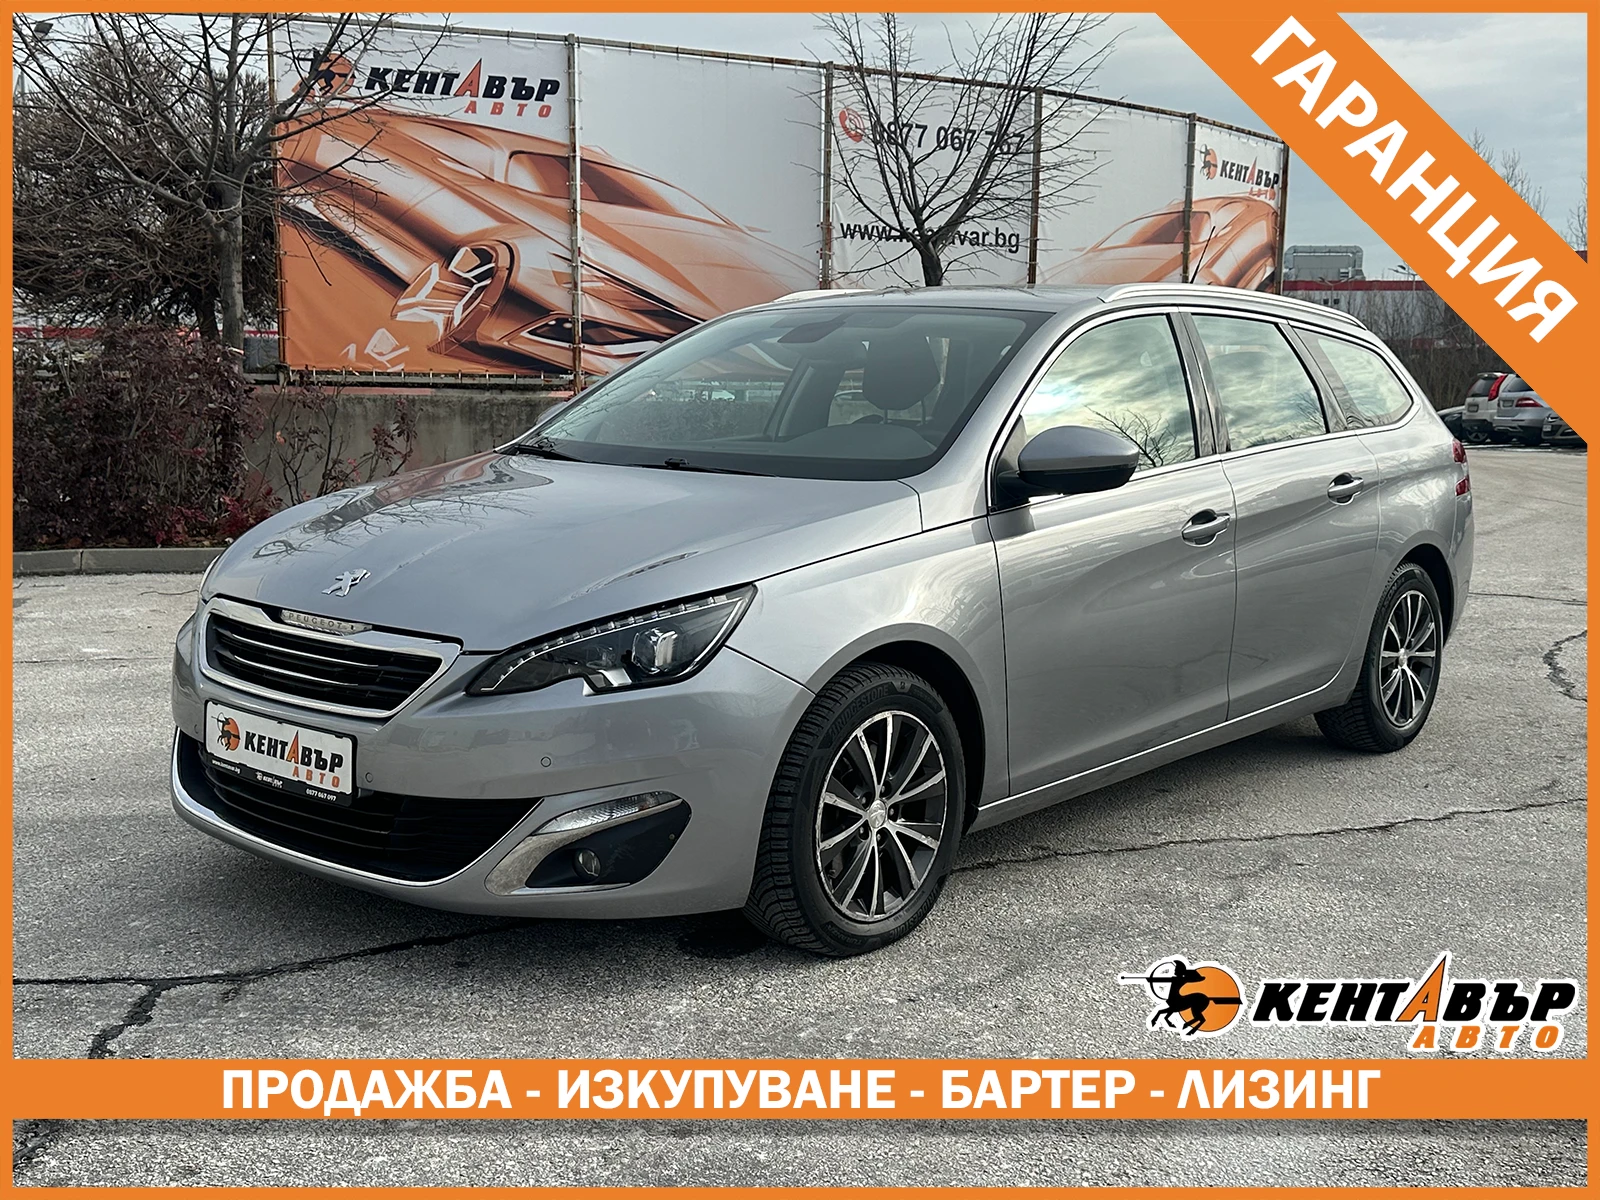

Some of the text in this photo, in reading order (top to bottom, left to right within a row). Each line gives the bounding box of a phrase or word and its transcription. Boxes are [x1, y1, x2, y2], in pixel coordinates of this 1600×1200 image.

[364, 58, 561, 102] КЕНТАВЪР
[464, 100, 552, 118] АВТО
[936, 126, 976, 152] 067
[1219, 155, 1280, 189] КЕНТАВЪР
[840, 222, 1020, 252] www.keavar.bg
[288, 612, 343, 630] PEUGEOT
[244, 729, 344, 773] КЕНТАВЪР
[292, 766, 340, 788] АВТО
